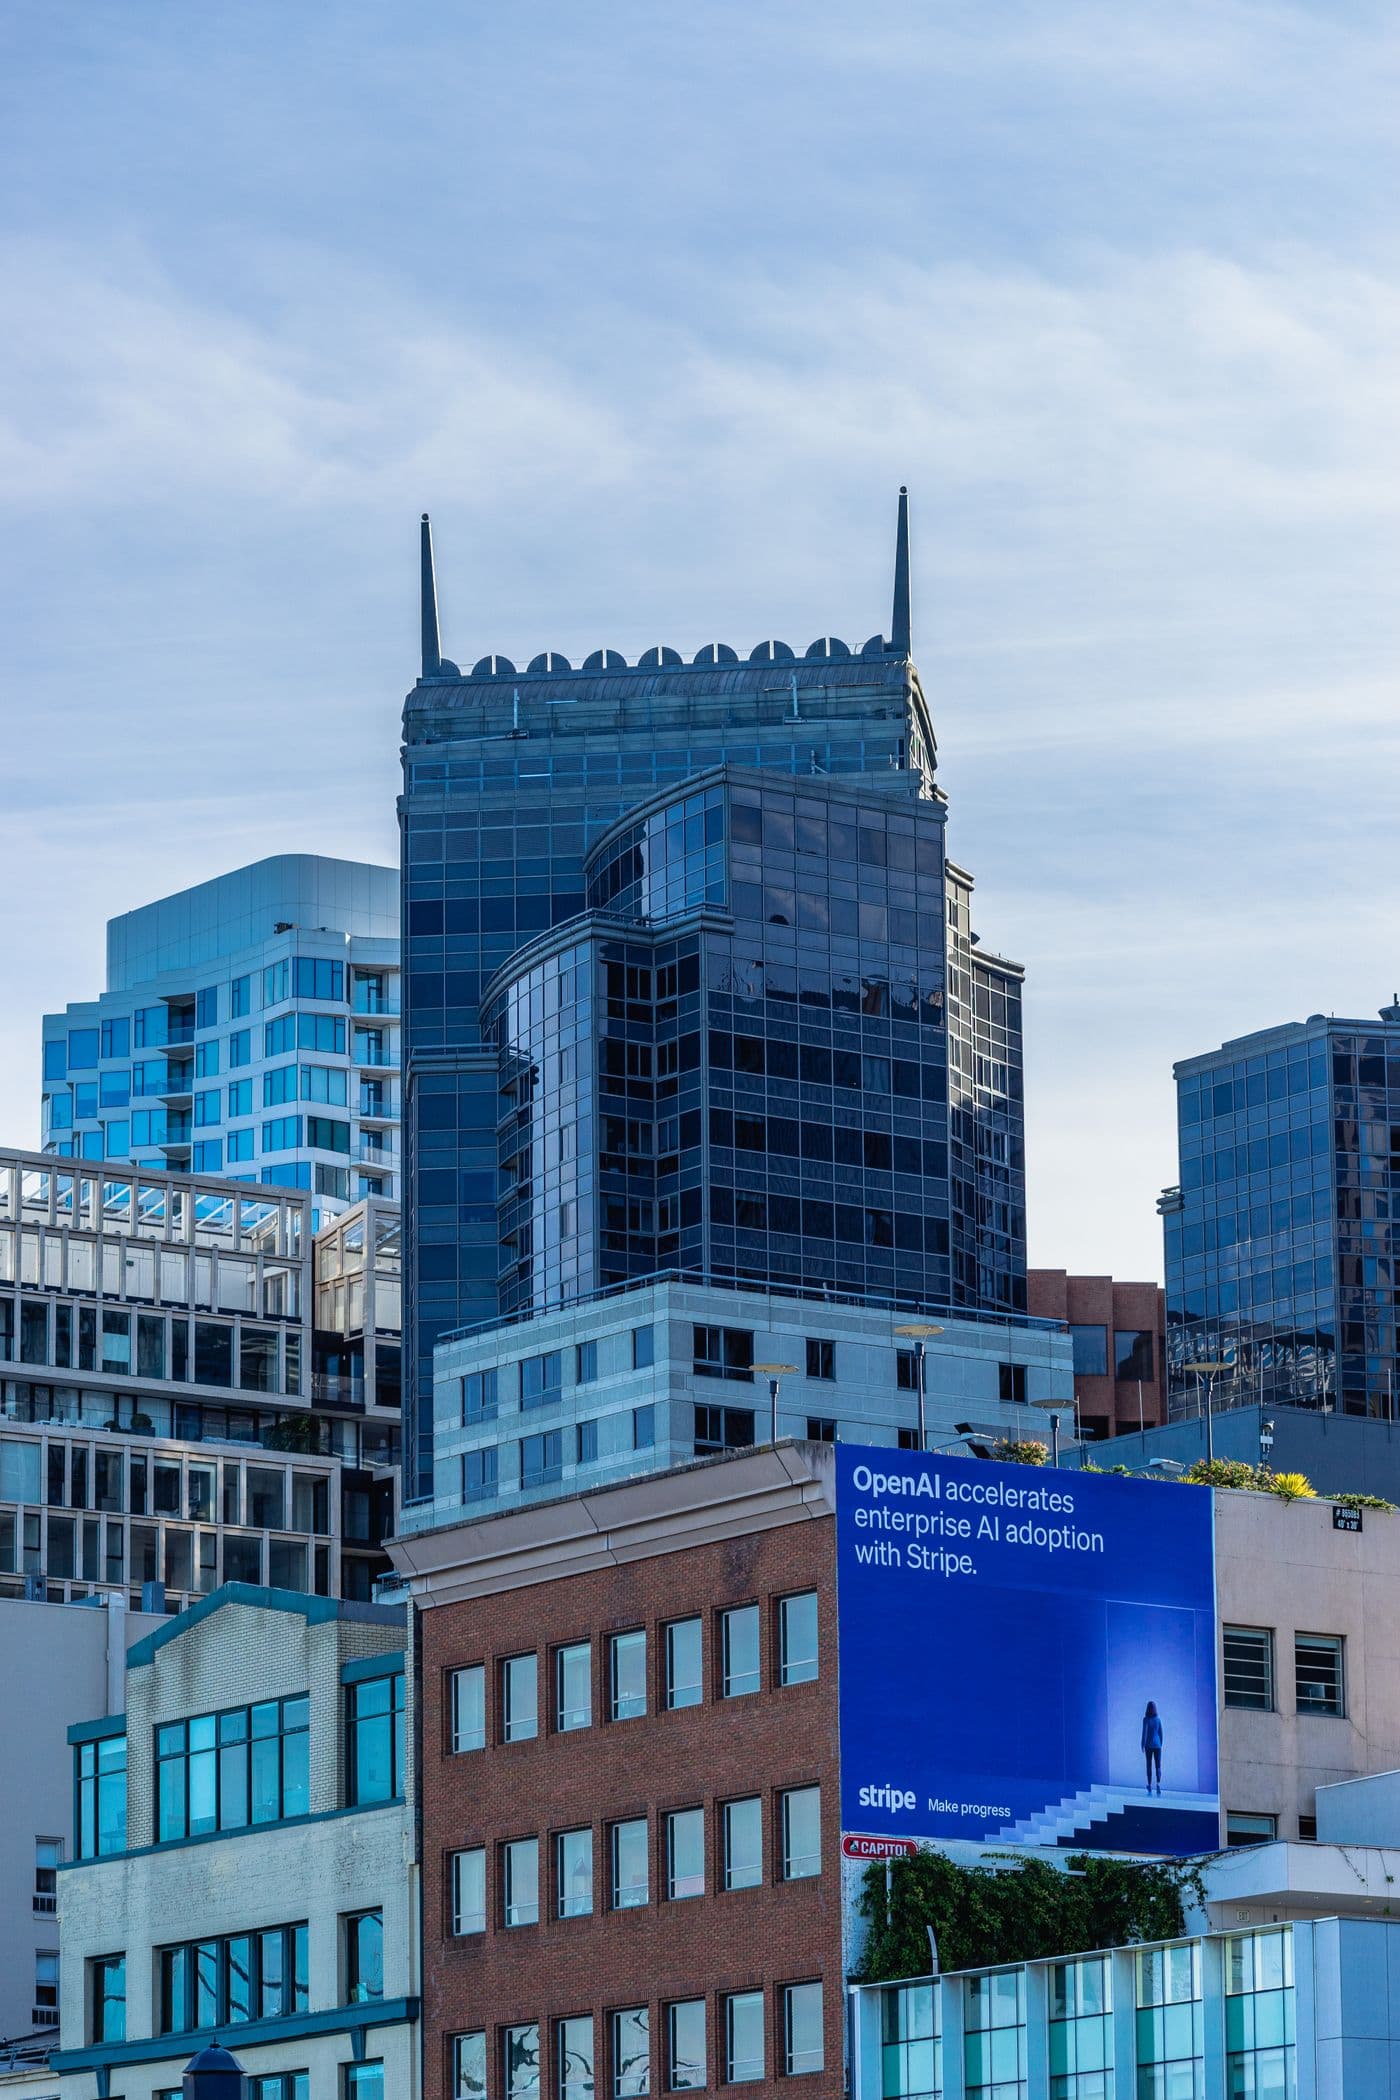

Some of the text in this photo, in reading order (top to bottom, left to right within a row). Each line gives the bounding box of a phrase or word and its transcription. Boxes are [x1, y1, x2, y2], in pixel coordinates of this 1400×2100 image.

[852, 1465, 1075, 1514] OpenAI accelerates
[854, 1505, 1104, 1553] enterprise AI adoption
[854, 1540, 977, 1578] with Stripe.
[858, 1783, 1012, 1818] stripe Make progress
